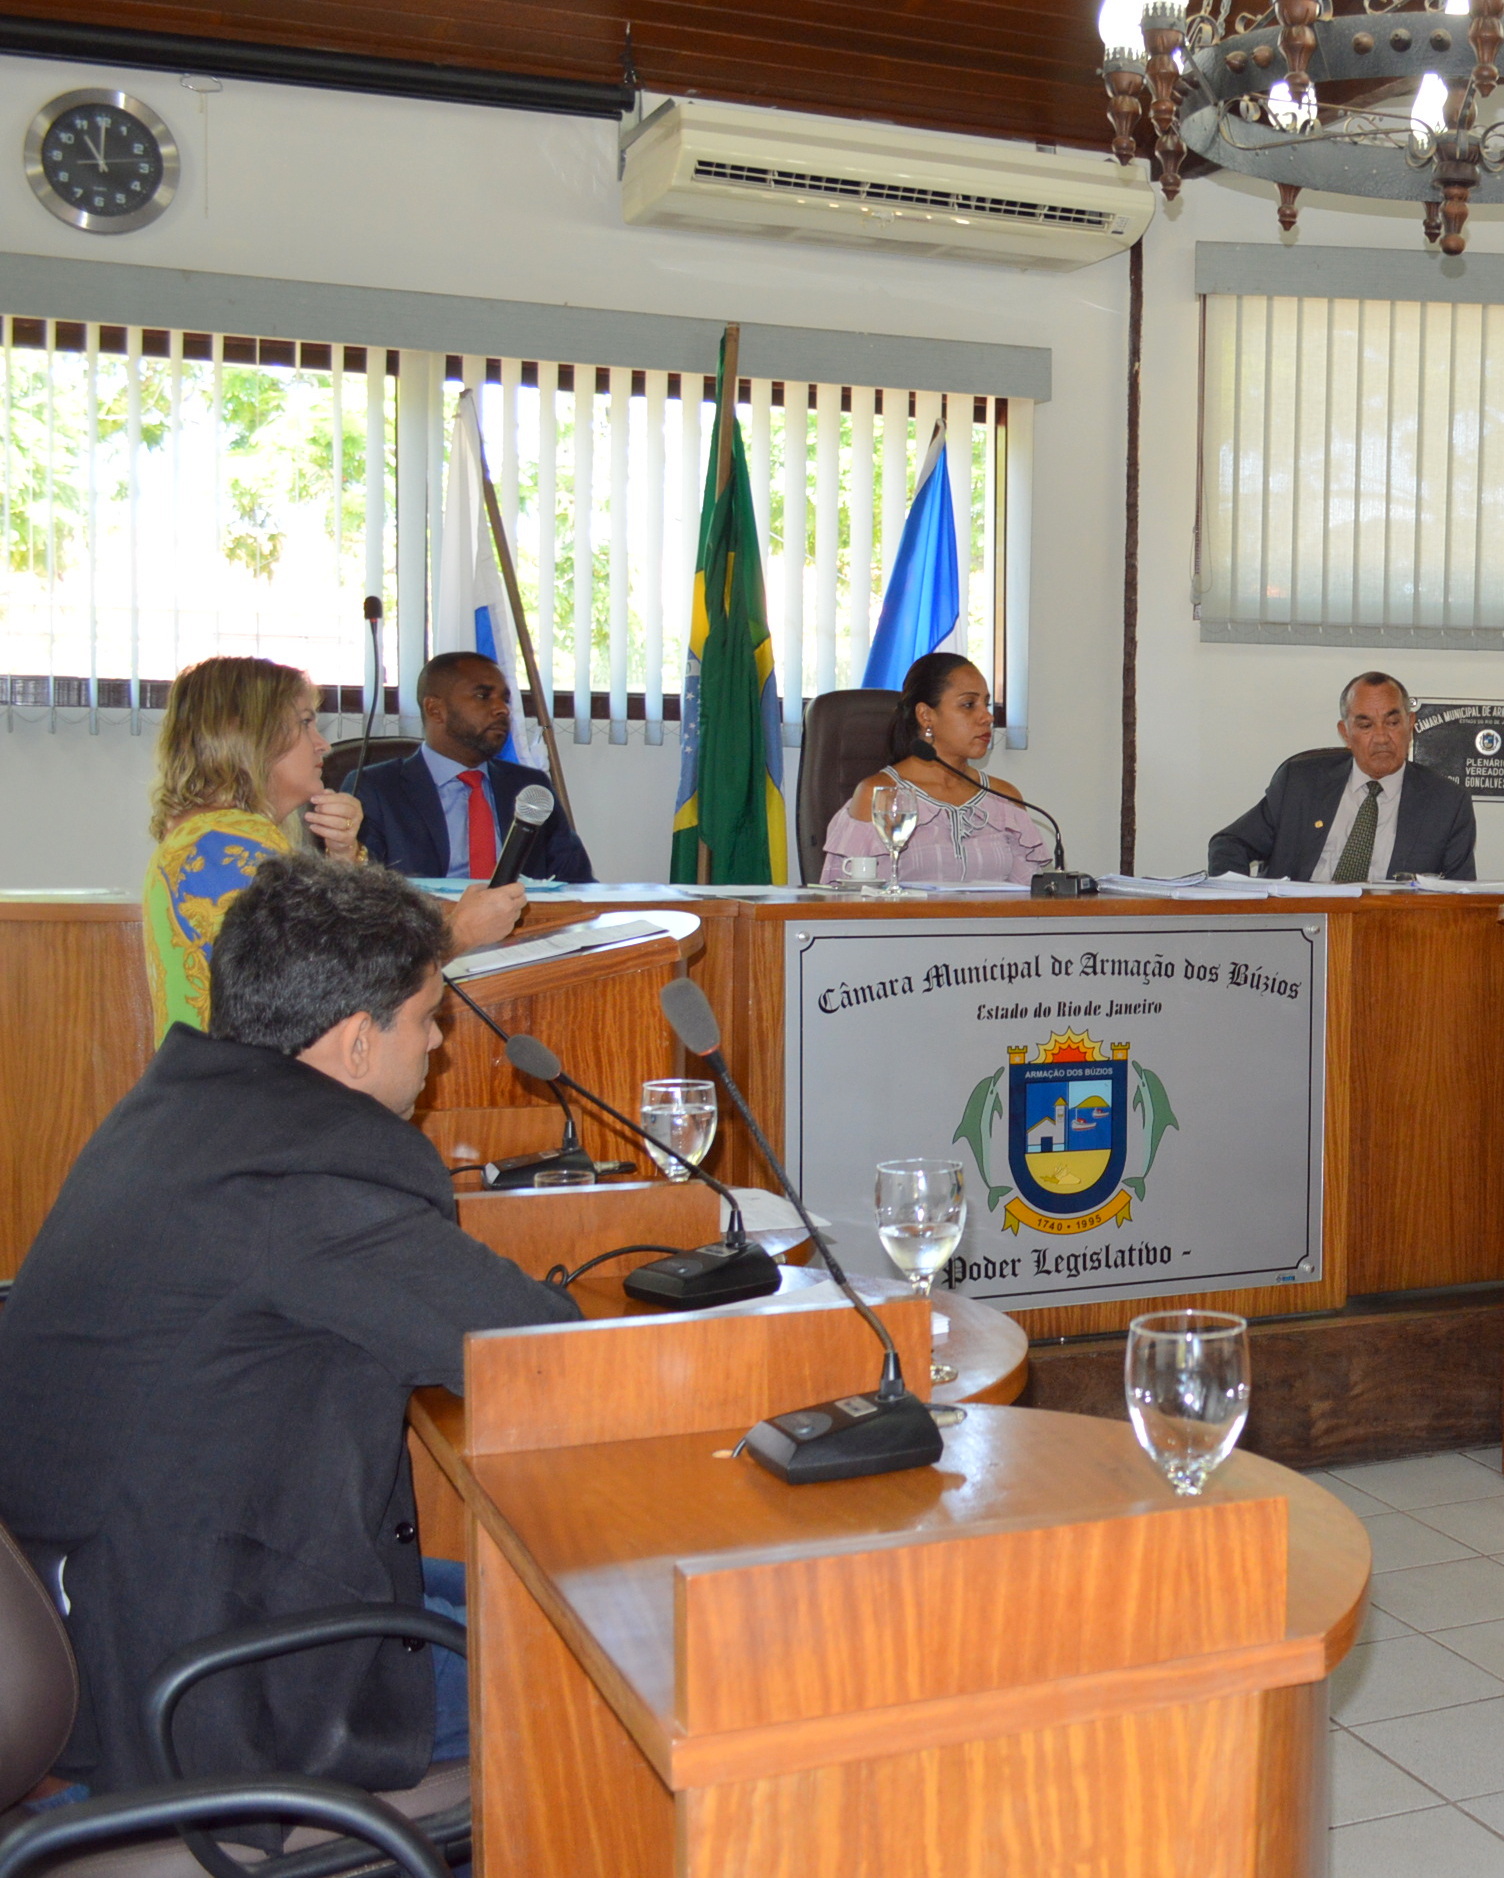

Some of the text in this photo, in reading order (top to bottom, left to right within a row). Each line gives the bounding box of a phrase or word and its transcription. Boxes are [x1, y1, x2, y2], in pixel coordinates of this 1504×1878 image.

[75, 119, 88, 130] 11
[120, 126, 127, 136] 1
[59, 132, 75, 145] 10
[133, 143, 144, 155] 2
[52, 150, 63, 161] 9
[139, 163, 149, 174] 3
[59, 171, 69, 182] 8
[130, 181, 141, 192] 4
[73, 188, 83, 198] 7
[115, 193, 126, 204] 5
[94, 196, 104, 207] 6
[1414, 713, 1443, 733] CÂMARA
[1443, 706, 1480, 722] MUNICIPAL
[1482, 706, 1492, 716] DE
[818, 952, 1302, 1014] Câmara Municipal de Armação dos Búzios
[976, 999, 1162, 1021] Estado do Rio de Janeiro
[1025, 1067, 1113, 1078] ARMAÇÃO DOS BÚZIOS
[1037, 1214, 1102, 1232] 1740 1995
[942, 1255, 1021, 1289] Poder
[1031, 1241, 1172, 1279] Legislativo
